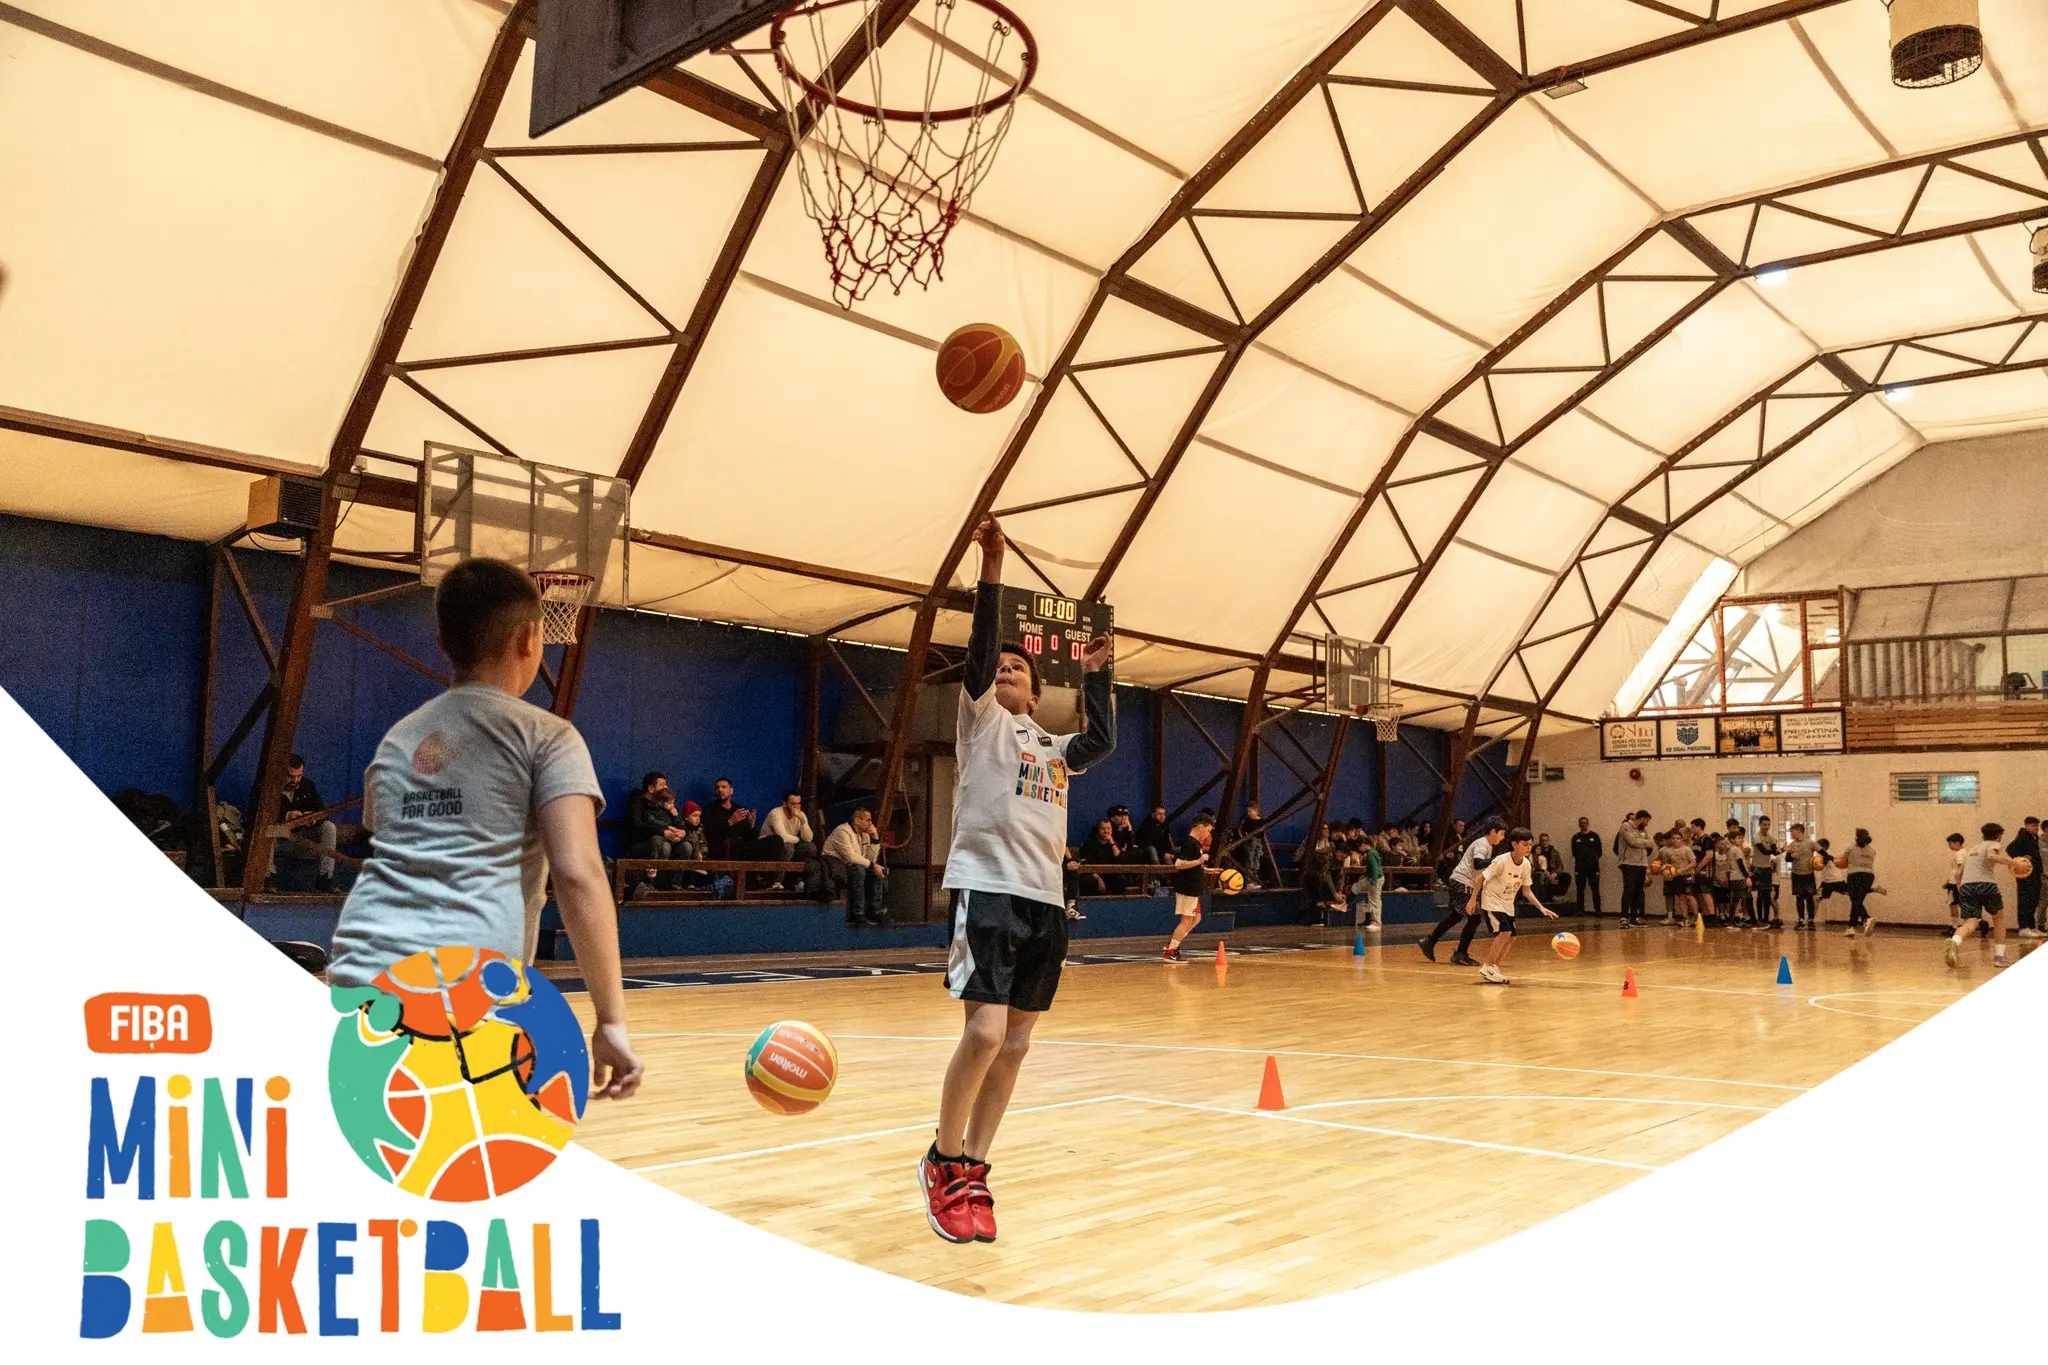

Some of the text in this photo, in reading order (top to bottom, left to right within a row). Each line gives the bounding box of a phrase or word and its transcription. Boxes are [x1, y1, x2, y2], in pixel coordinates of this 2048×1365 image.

[1040, 598, 1075, 620] 10:00
[1019, 622, 1044, 635] HOME
[1065, 628, 1092, 643] GUEST
[1050, 634, 1058, 651] 0
[403, 788, 462, 804] BASKETBALL
[401, 801, 462, 820] FOR GOOD
[767, 1052, 808, 1080] molten
